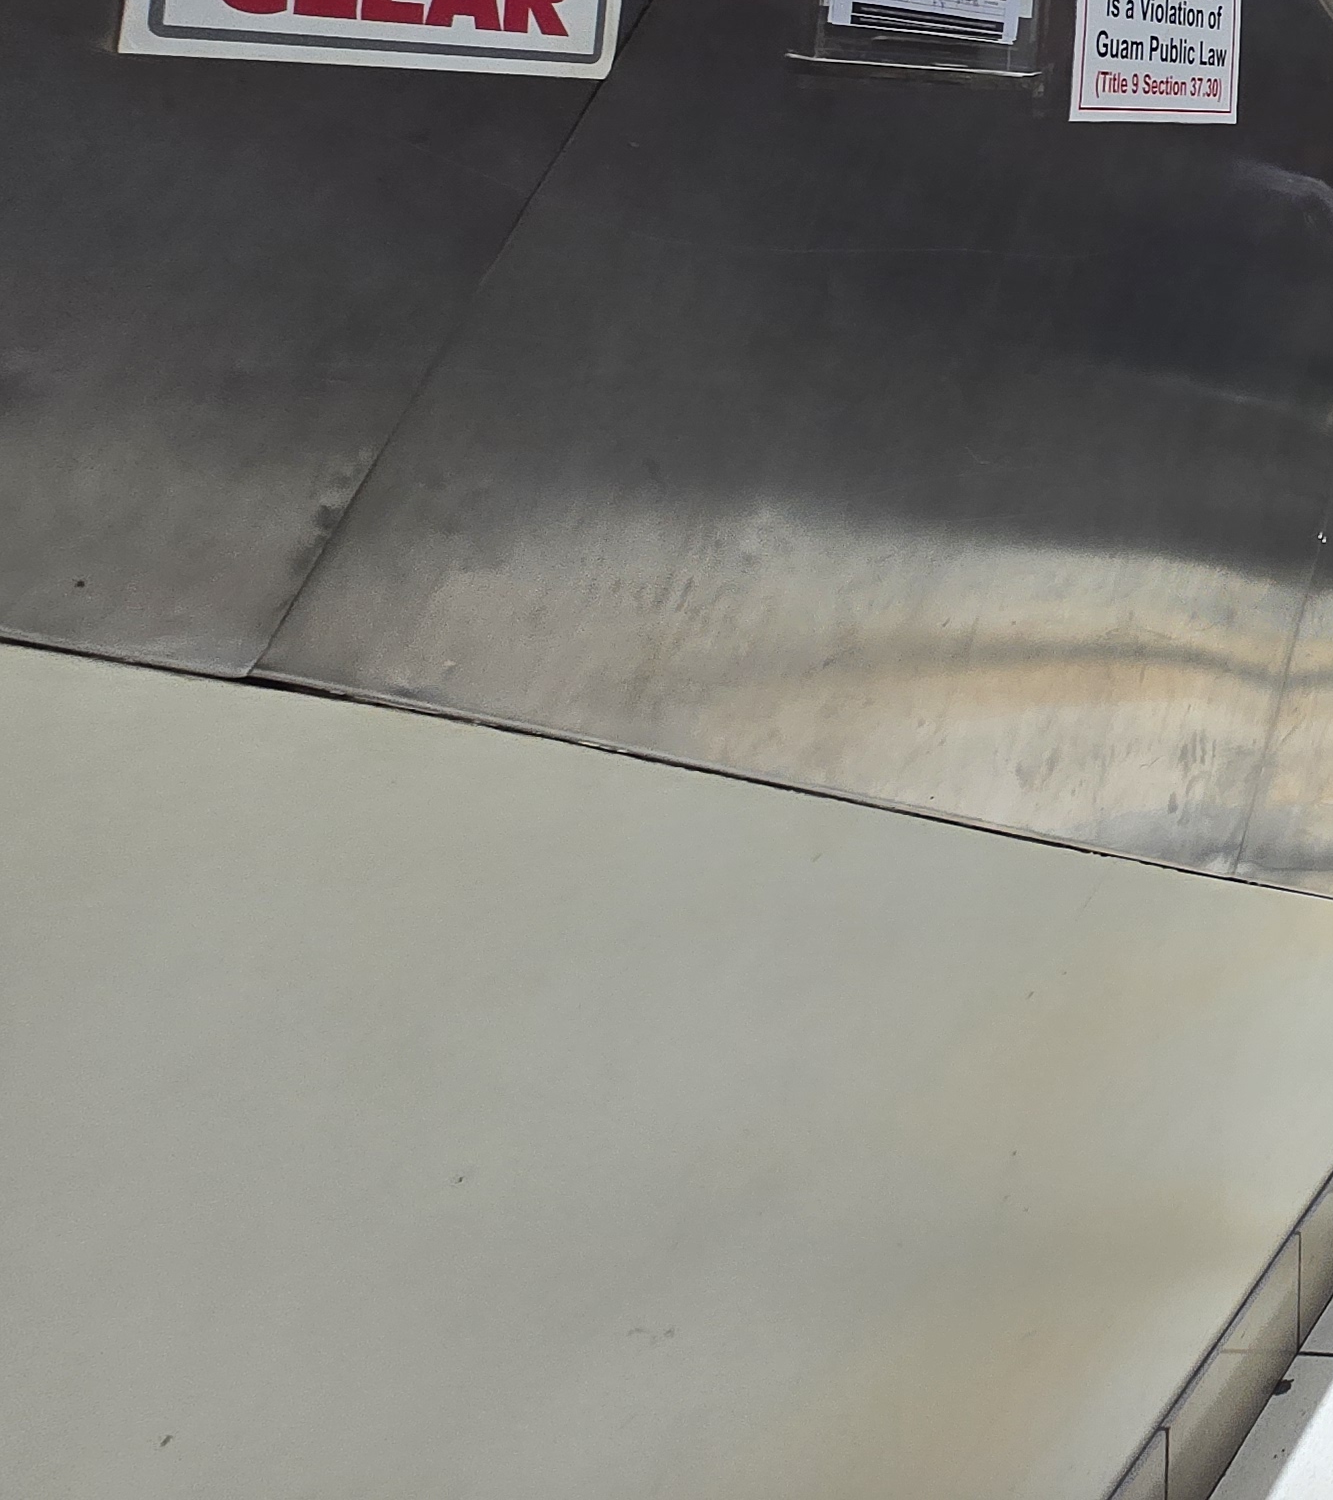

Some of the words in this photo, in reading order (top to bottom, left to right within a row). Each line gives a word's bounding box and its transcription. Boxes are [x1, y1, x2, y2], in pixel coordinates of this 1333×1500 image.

[1126, 0, 1135, 20] a
[1208, 5, 1223, 31] of
[1096, 30, 1144, 61] Guam
[1149, 35, 1196, 65] Public
[1199, 40, 1227, 67] Law
[1095, 70, 1128, 99] (Title
[1131, 73, 1140, 94] 9
[1142, 73, 1187, 97] Section
[1189, 77, 1222, 103] 37.30)
